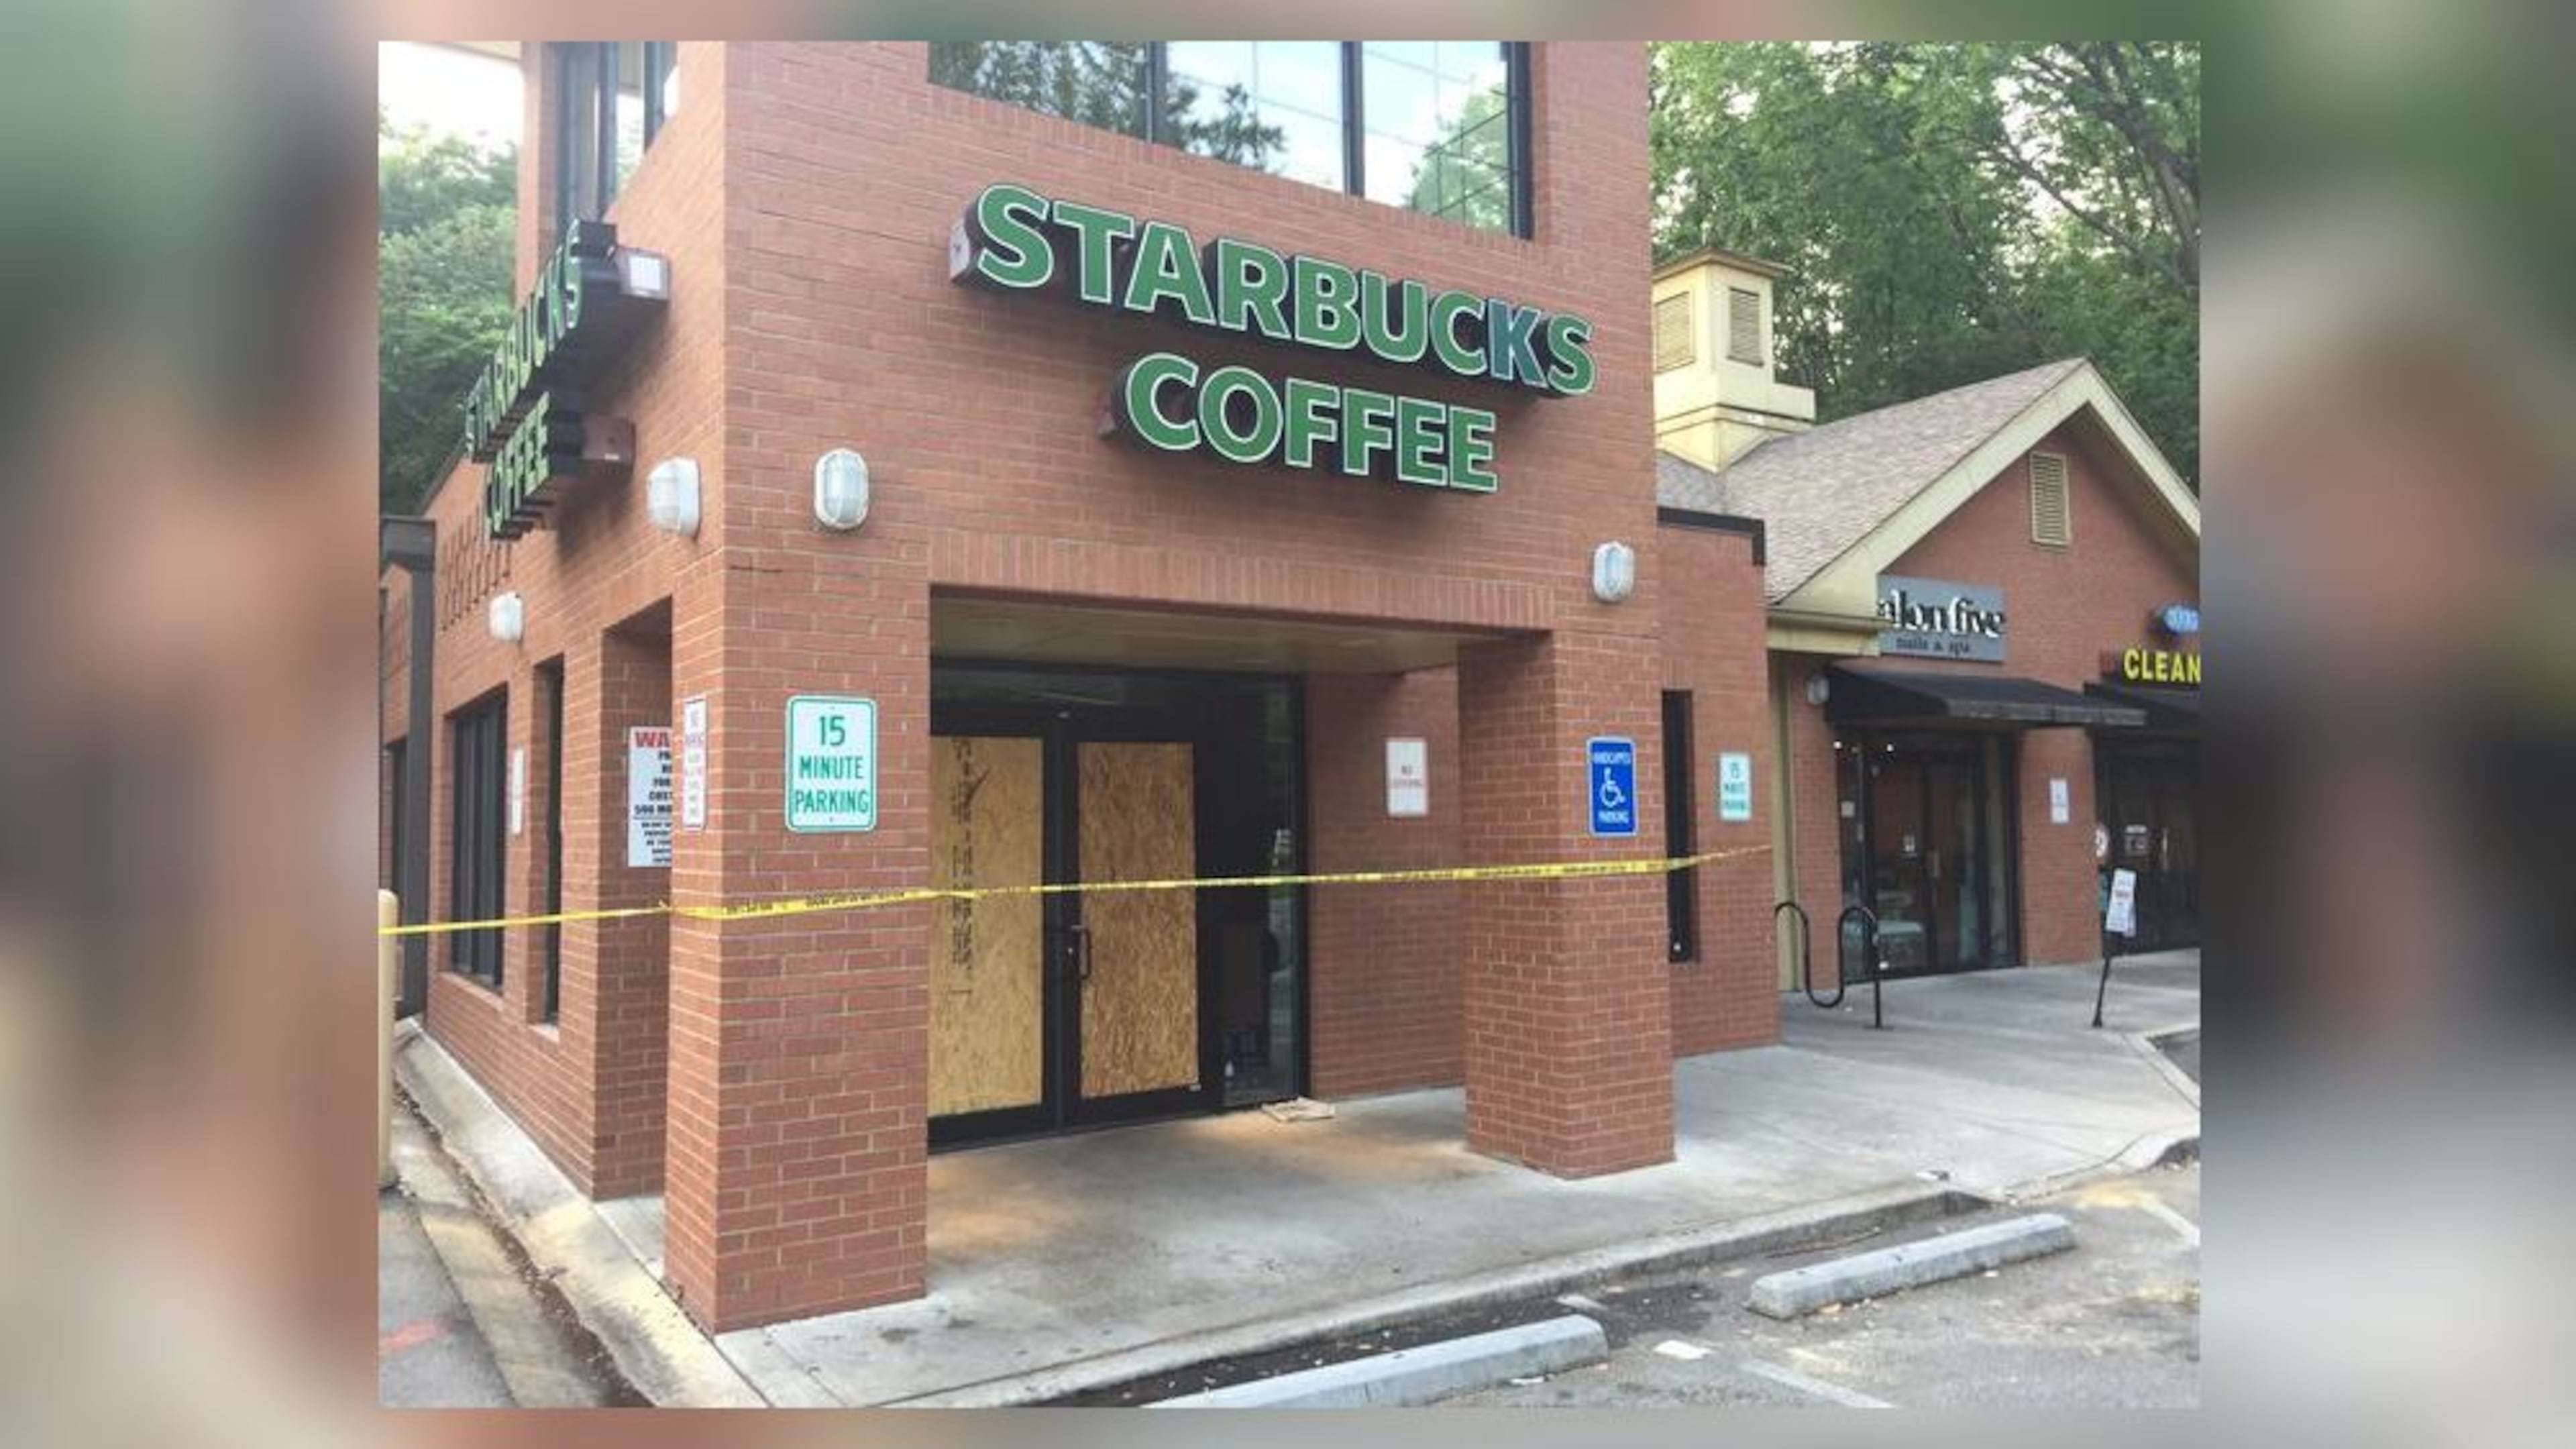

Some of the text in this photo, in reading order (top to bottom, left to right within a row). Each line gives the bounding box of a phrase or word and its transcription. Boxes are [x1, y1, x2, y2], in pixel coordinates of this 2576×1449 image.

[977, 184, 1596, 394] STARBUCKS
[465, 219, 582, 460] STARBUCKS
[1124, 352, 1498, 492] COFFEE
[484, 391, 550, 541] COFFEE
[1947, 596, 2005, 638] five
[2123, 648, 2200, 683] CLEAN
[819, 715, 846, 746] 15
[799, 755, 865, 780] MINUTE
[794, 789, 869, 814] PARKING
